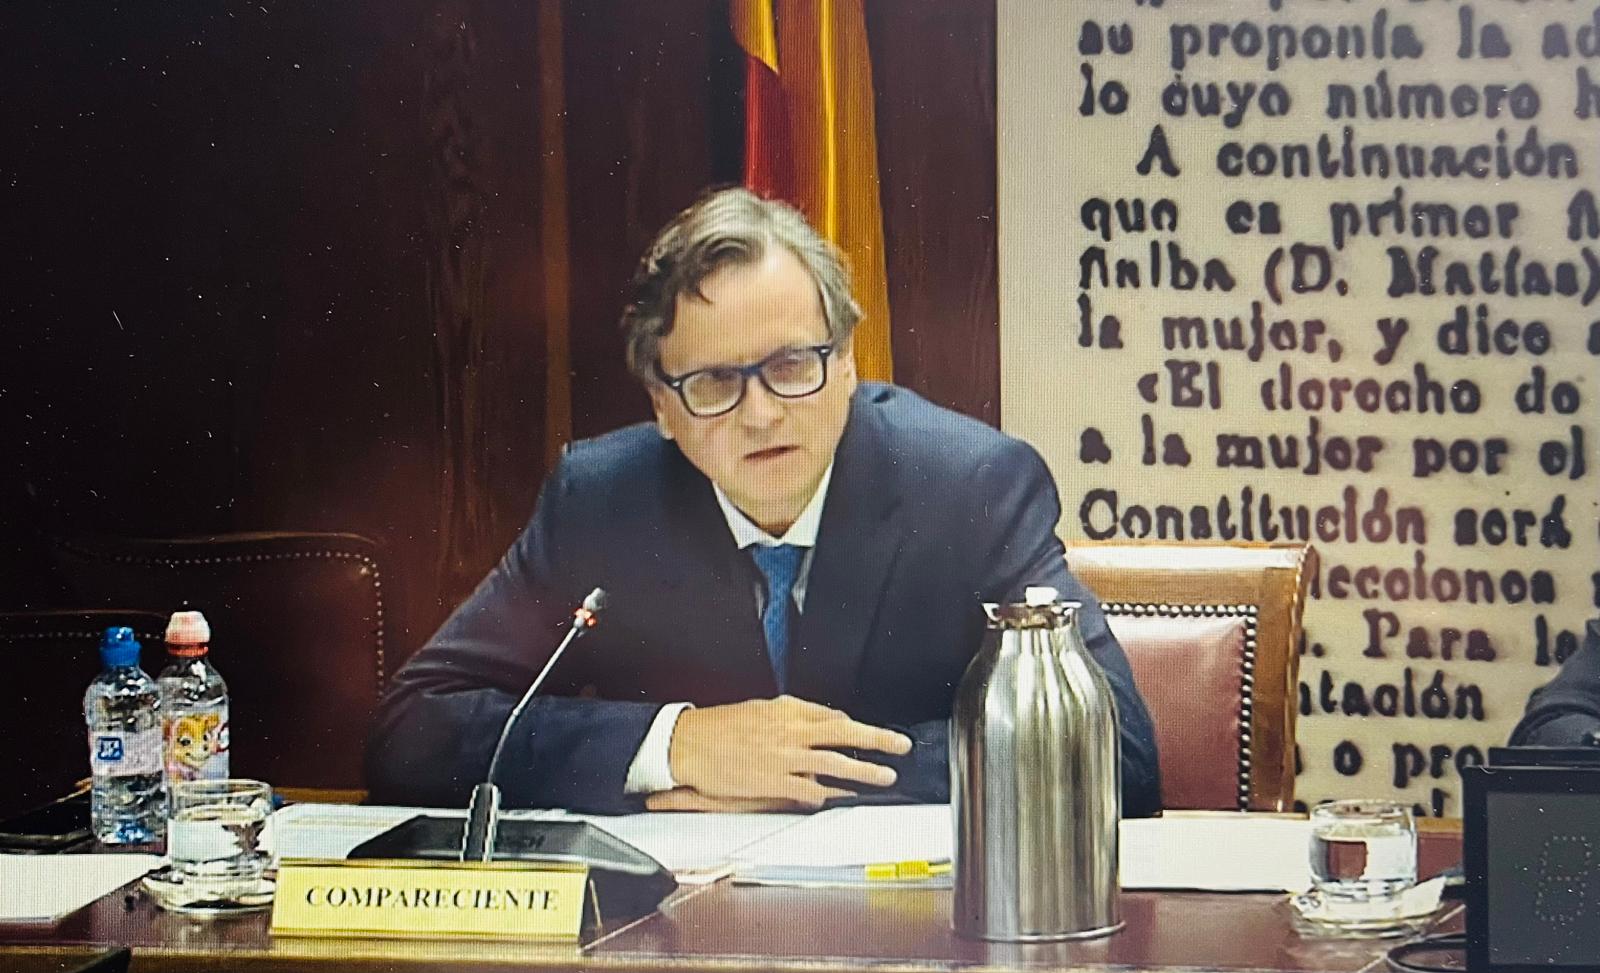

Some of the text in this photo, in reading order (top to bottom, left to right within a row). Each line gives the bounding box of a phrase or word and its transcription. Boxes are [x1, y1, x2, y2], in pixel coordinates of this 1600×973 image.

[1458, 6, 1510, 58] la
[1079, 63, 1129, 116] lo
[1136, 124, 1180, 177] A
[1077, 292, 1123, 349] la
[1374, 318, 1409, 365] y
[1080, 428, 1111, 464] a
[1142, 414, 1191, 467] la
[1413, 438, 1508, 478] por
[1363, 609, 1498, 662] Para
[307, 885, 559, 912] COMPARECIENTE
